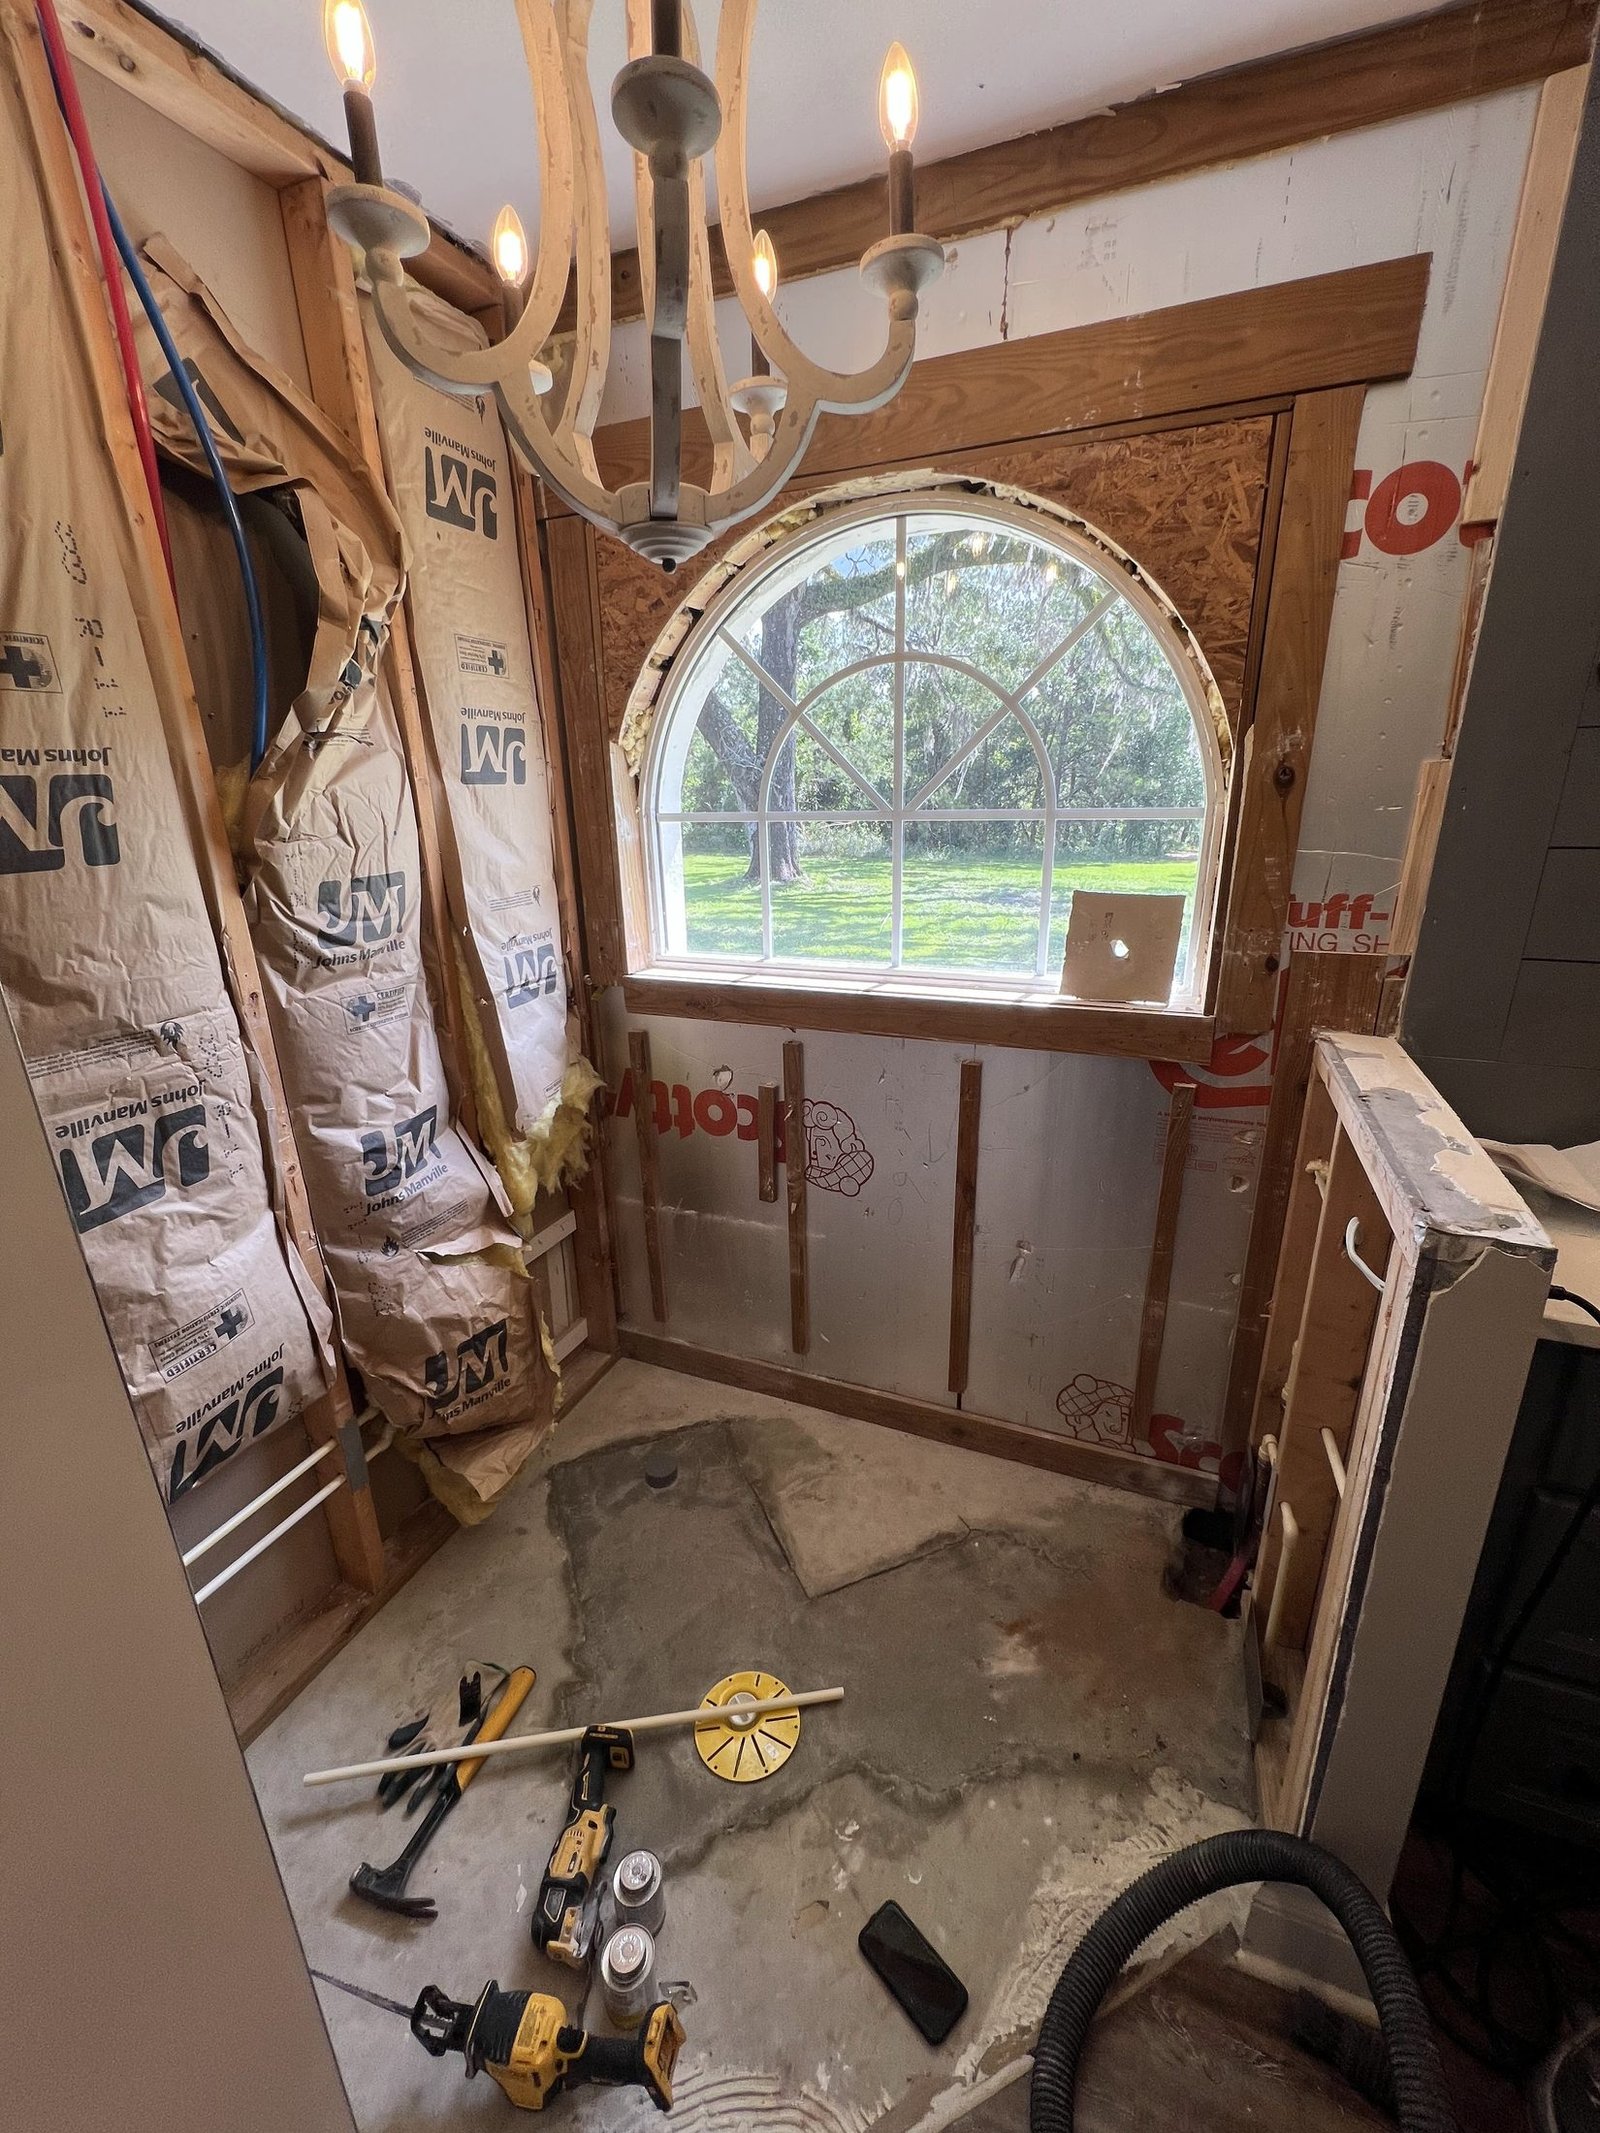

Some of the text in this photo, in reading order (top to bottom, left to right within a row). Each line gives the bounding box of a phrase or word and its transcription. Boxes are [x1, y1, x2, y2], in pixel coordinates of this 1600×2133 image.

[424, 427, 497, 472] Johns Manville
[424, 446, 498, 541] JM
[460, 707, 526, 724] Johns Manville
[0, 747, 112, 767] Johns Ma
[460, 722, 527, 786] JM
[317, 870, 406, 950] JM
[1288, 892, 1398, 930] uff-
[532, 927, 553, 943] Johns
[1352, 933, 1390, 954] SH
[312, 953, 358, 969] Johns
[54, 1079, 206, 1140] Johns Manville
[59, 1103, 210, 1235] JM
[361, 1104, 442, 1197] JM
[366, 1163, 449, 1217] Johns Manville
[165, 1342, 217, 1378] CERTIFIED
[246, 1342, 285, 1383] Johns
[425, 1318, 509, 1411] JM
[175, 1376, 245, 1435] Manville
[461, 1377, 512, 1413] Manville
[169, 1366, 284, 1505] JM
